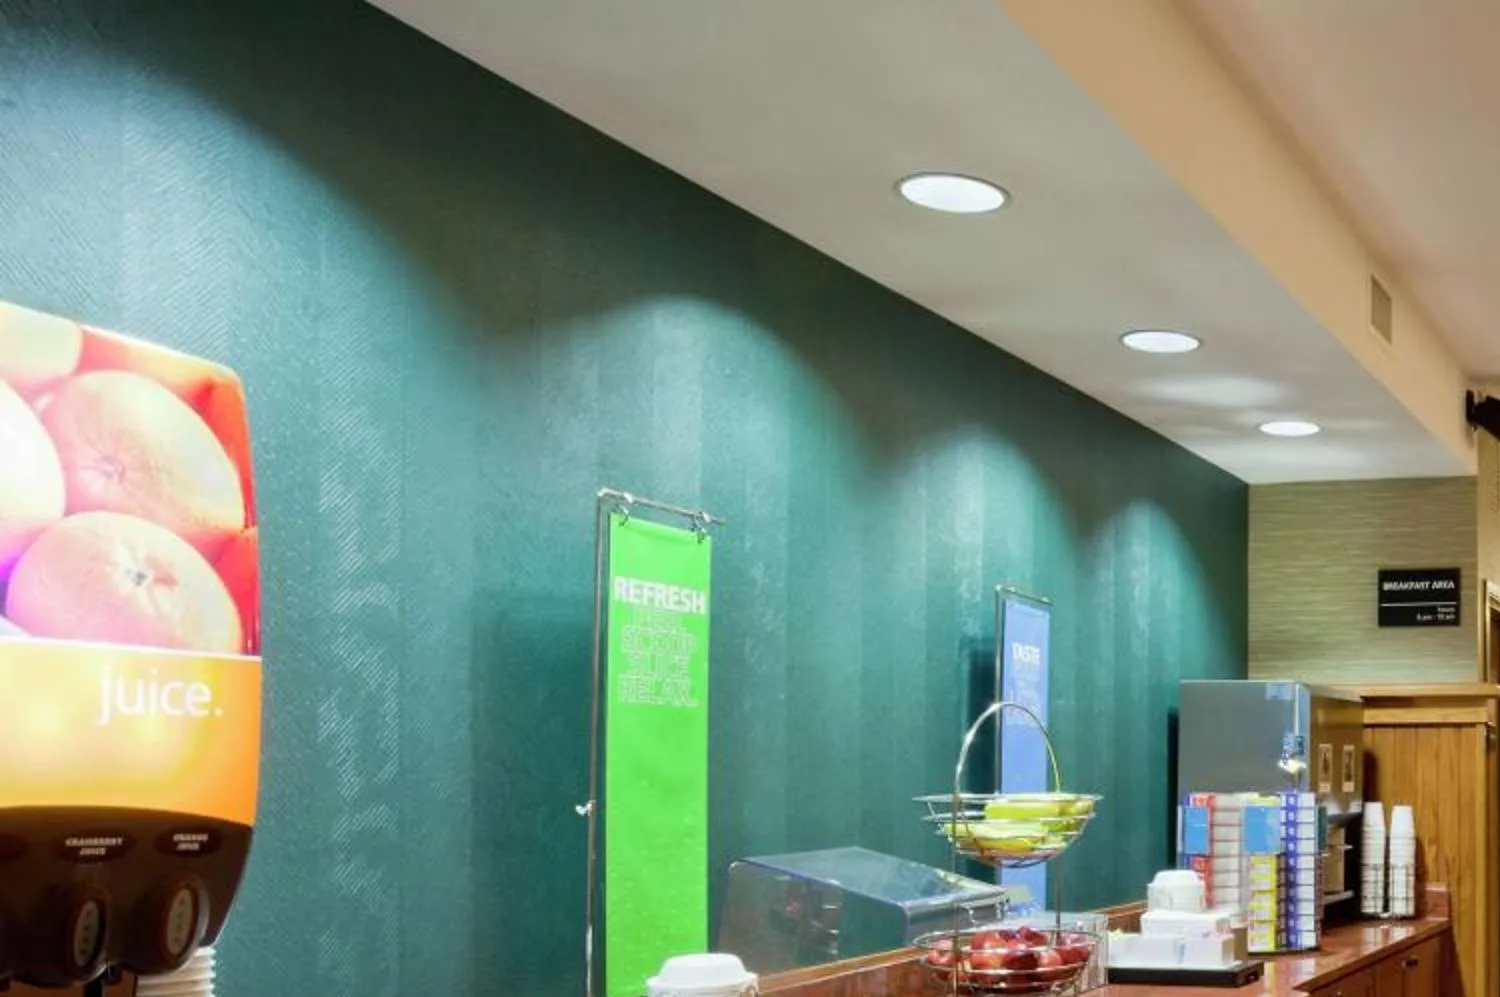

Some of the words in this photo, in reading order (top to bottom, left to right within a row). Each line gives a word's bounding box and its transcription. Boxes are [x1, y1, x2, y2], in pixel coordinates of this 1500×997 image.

[613, 575, 706, 614] REFRESH
[1383, 581, 1429, 591] BREAKFAST
[1432, 580, 1455, 589] AREA
[97, 666, 223, 726] juice.
